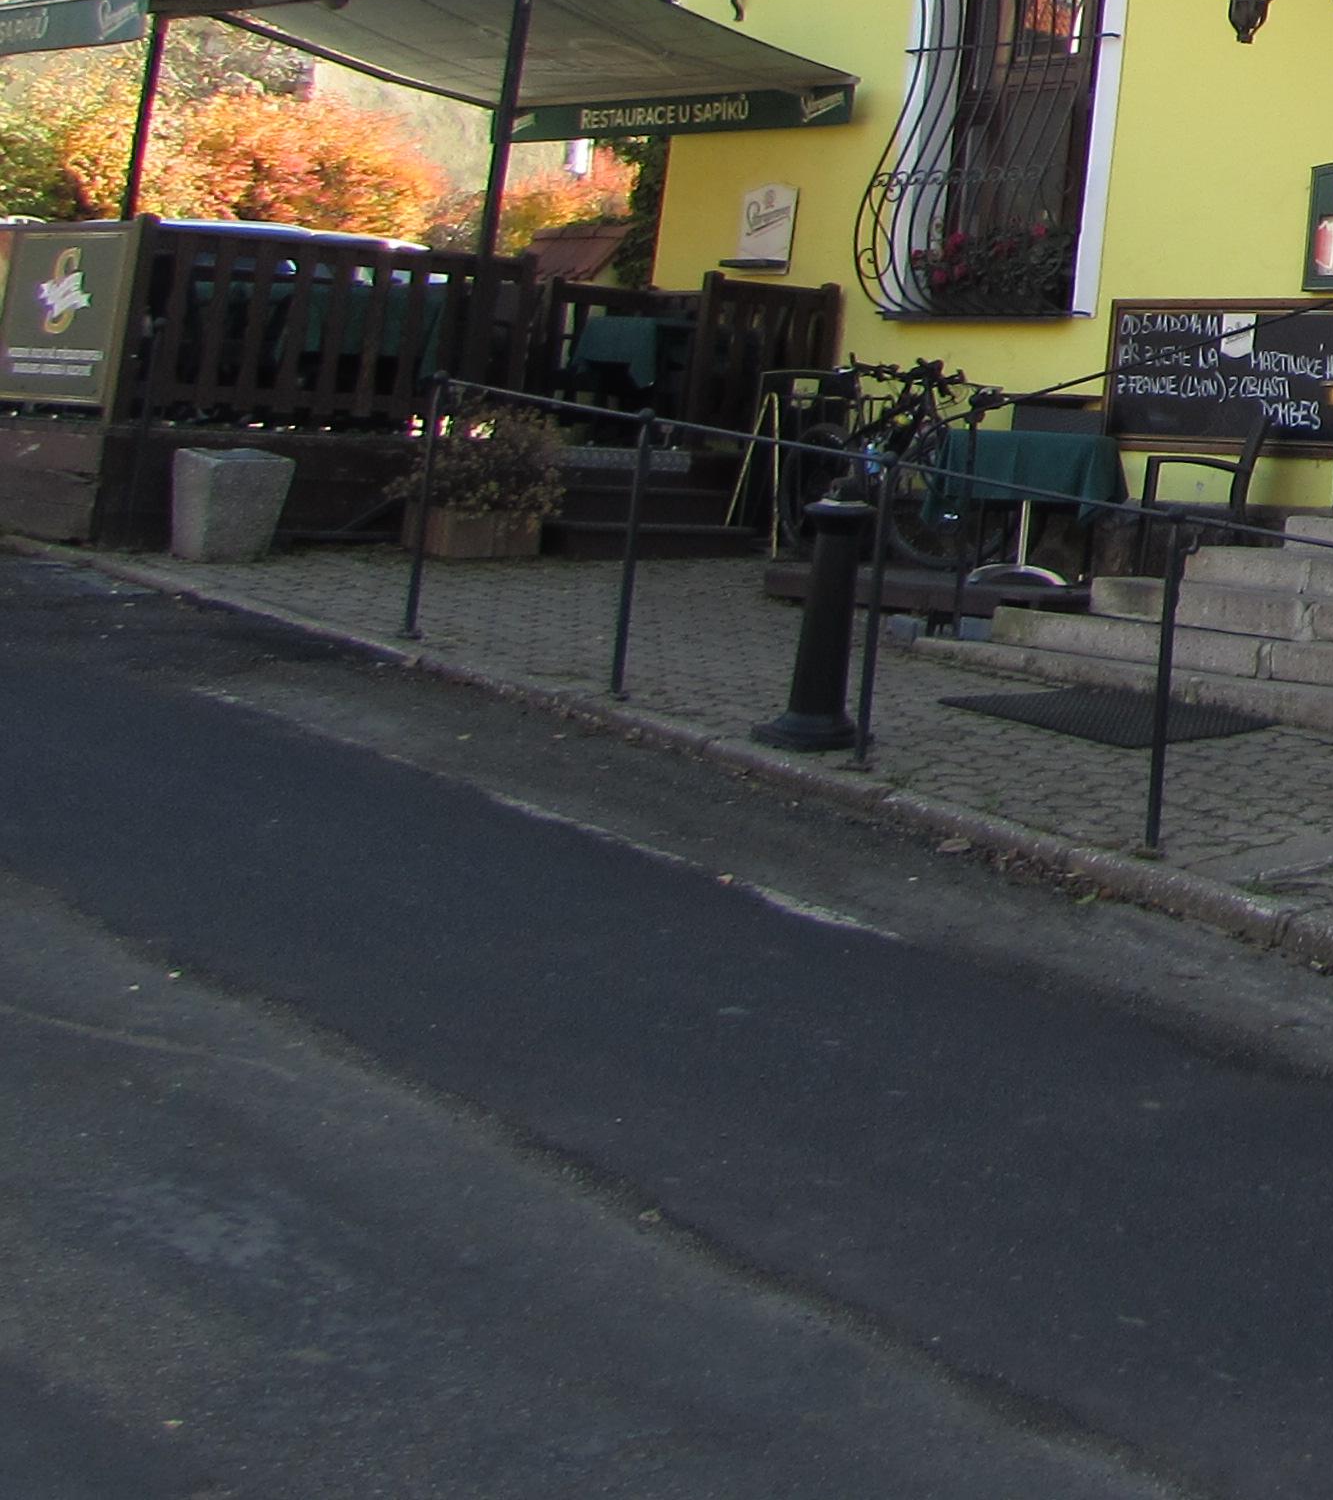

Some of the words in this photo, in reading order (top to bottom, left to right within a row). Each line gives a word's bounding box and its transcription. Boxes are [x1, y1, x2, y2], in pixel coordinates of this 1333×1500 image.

[580, 104, 676, 130] RESTAURACE
[678, 104, 691, 123] U
[693, 93, 749, 123] SAPÍKŮ
[1120, 314, 1141, 336] OD
[1180, 371, 1226, 403] (LYON)
[1240, 376, 1290, 399] OBLASTI
